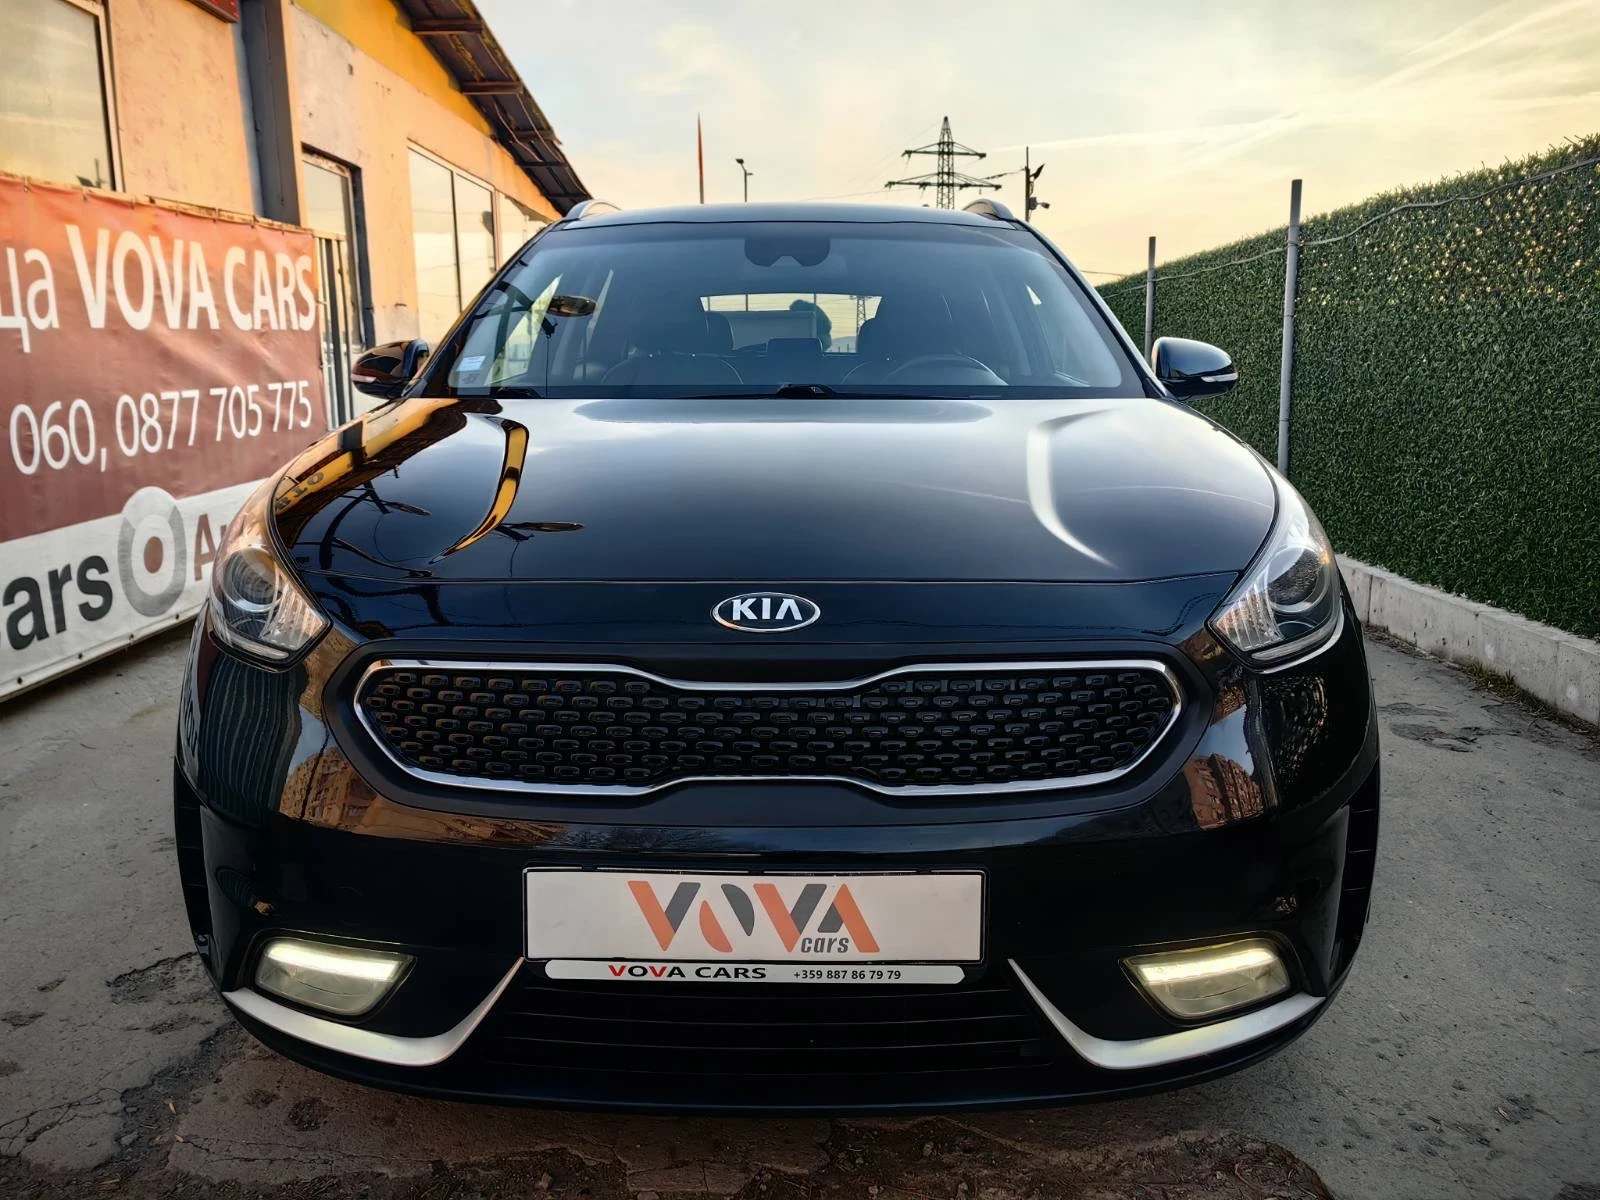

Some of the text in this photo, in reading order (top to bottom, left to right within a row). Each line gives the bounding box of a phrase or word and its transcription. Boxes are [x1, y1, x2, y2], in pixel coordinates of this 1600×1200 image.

[65, 223, 221, 331] VOVA
[223, 246, 317, 332] CARS
[9, 380, 313, 475] 060, 0877 705 775
[731, 597, 803, 621] KIA
[627, 880, 881, 953] VOVA
[800, 936, 850, 954] cars
[608, 964, 902, 980] VOVA CARS +359 887 86 79 79
